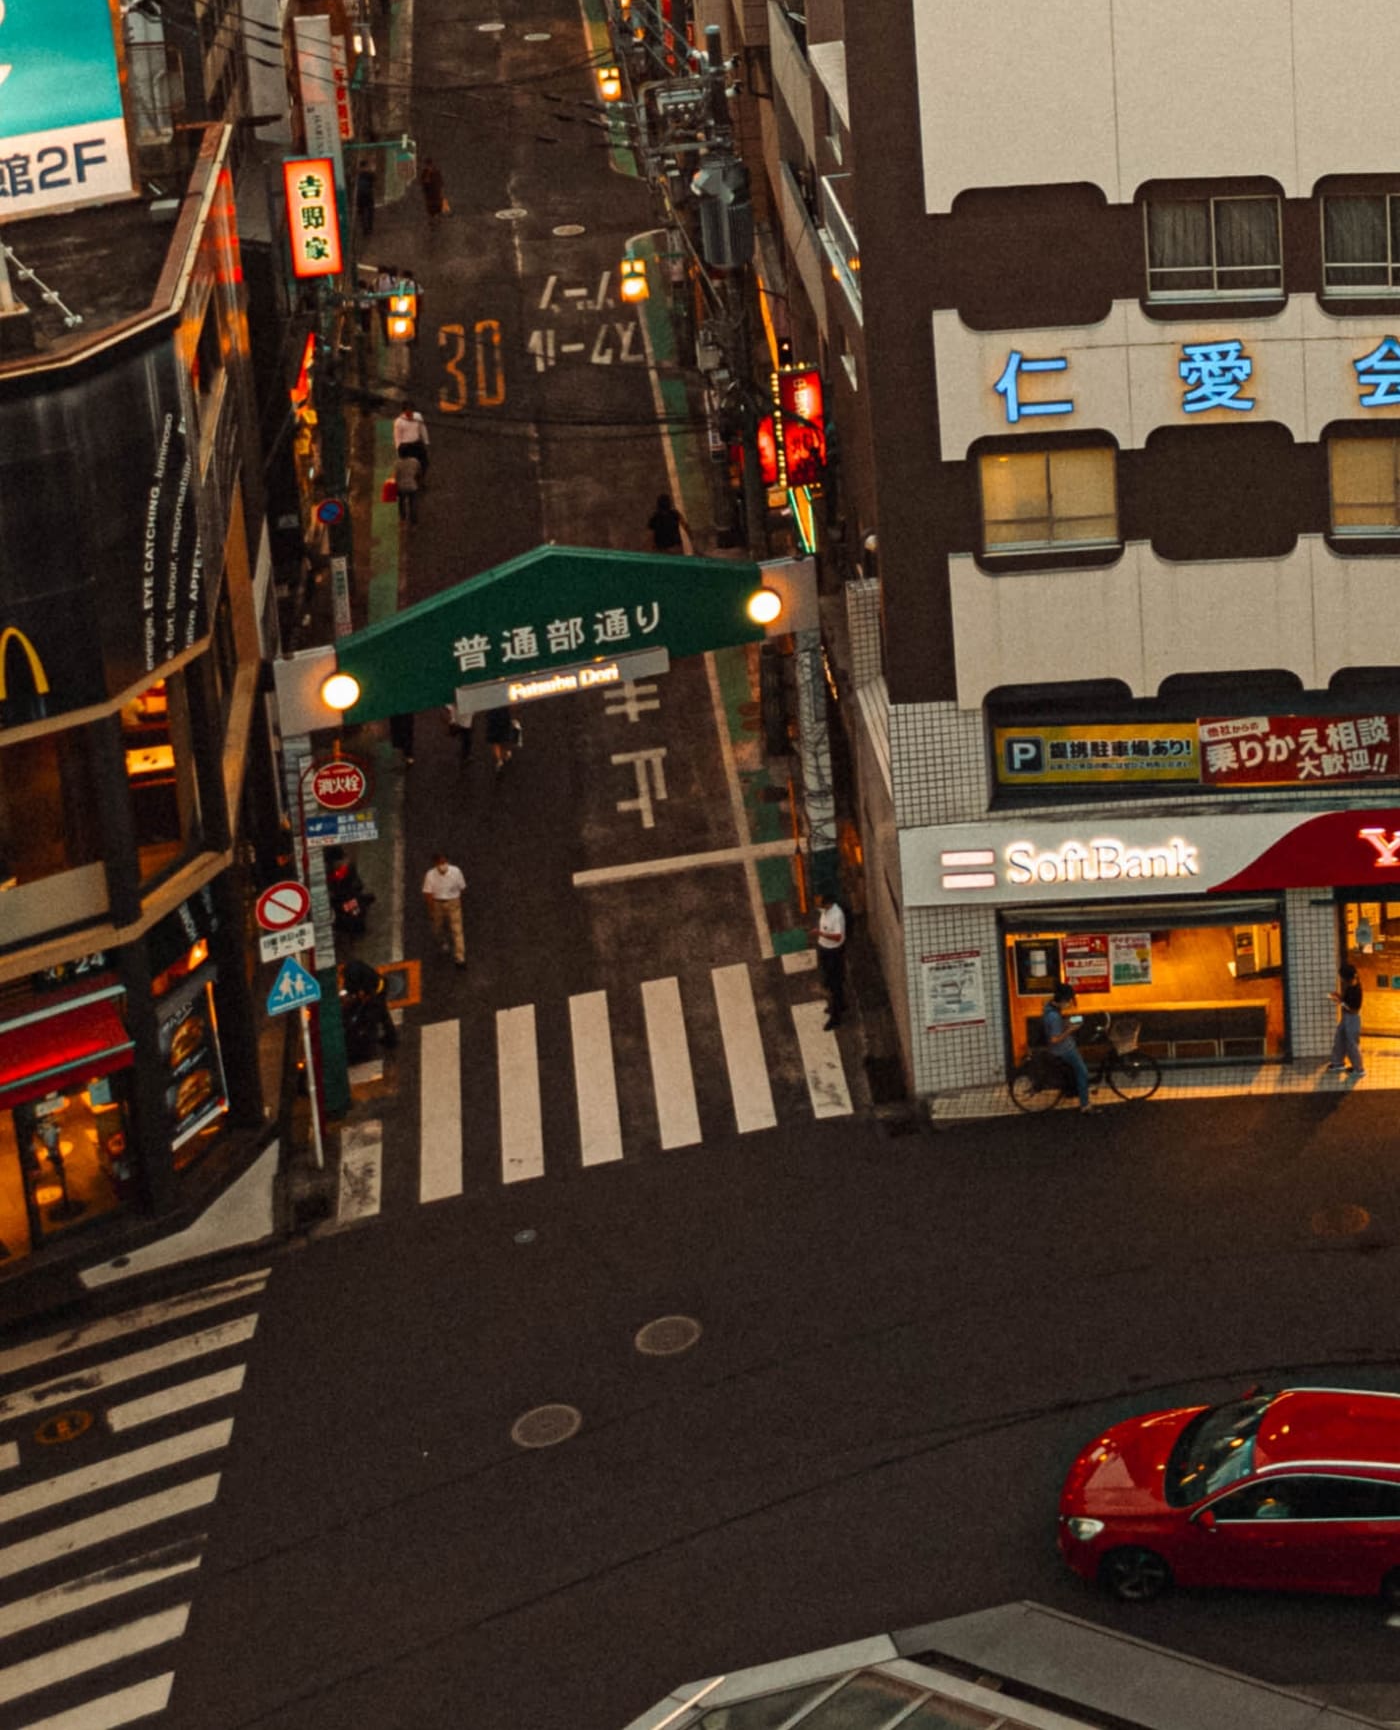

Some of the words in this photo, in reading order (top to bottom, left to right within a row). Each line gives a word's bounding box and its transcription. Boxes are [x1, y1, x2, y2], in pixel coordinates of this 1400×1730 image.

[298, 174, 330, 261] 吉野家
[438, 319, 505, 413] 30
[526, 320, 645, 372] スクール
[143, 576, 156, 610] EYE
[452, 601, 662, 672] 普通部通り
[578, 662, 620, 687] Dori
[1012, 742, 1037, 770] P
[1206, 715, 1391, 774] 乗りかえ相談
[316, 774, 358, 794] 消火栓
[1007, 837, 1199, 886] SoftBank
